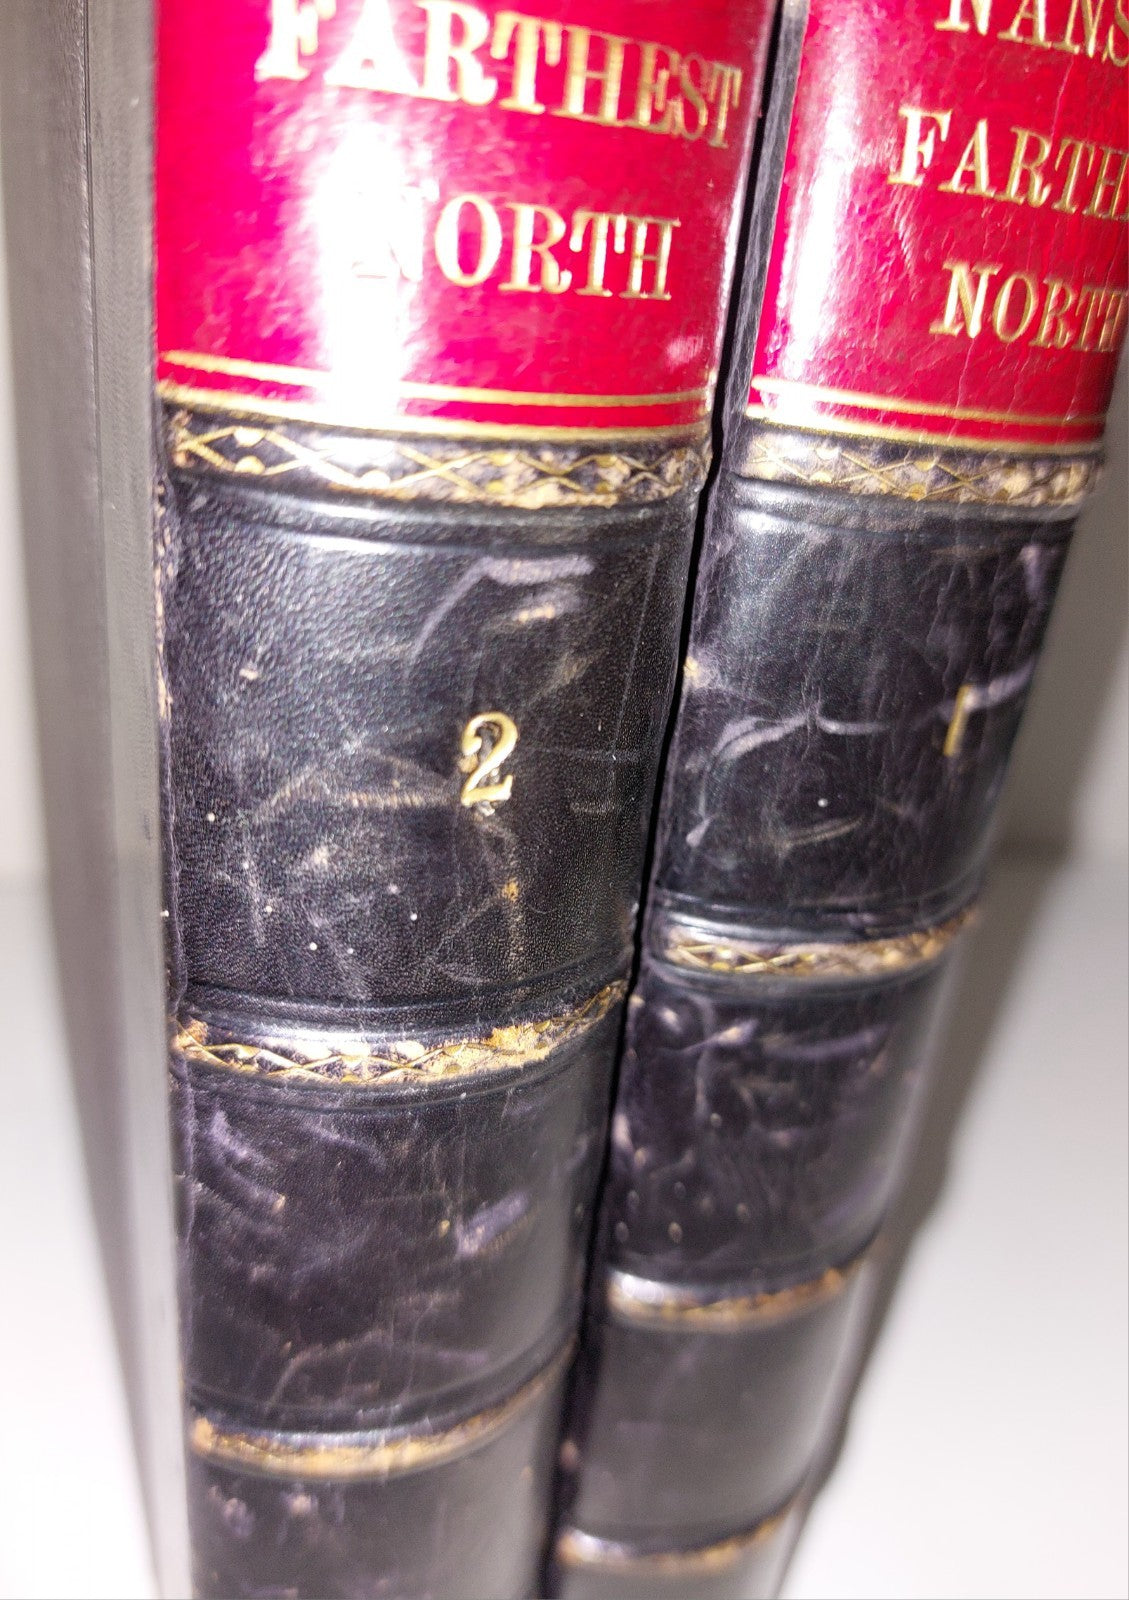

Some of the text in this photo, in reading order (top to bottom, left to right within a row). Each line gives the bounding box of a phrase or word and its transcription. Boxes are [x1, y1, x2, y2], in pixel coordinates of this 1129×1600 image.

[254, 0, 743, 148] FARTHEST
[930, 262, 1128, 353] NORTH
[461, 711, 520, 807] 2
